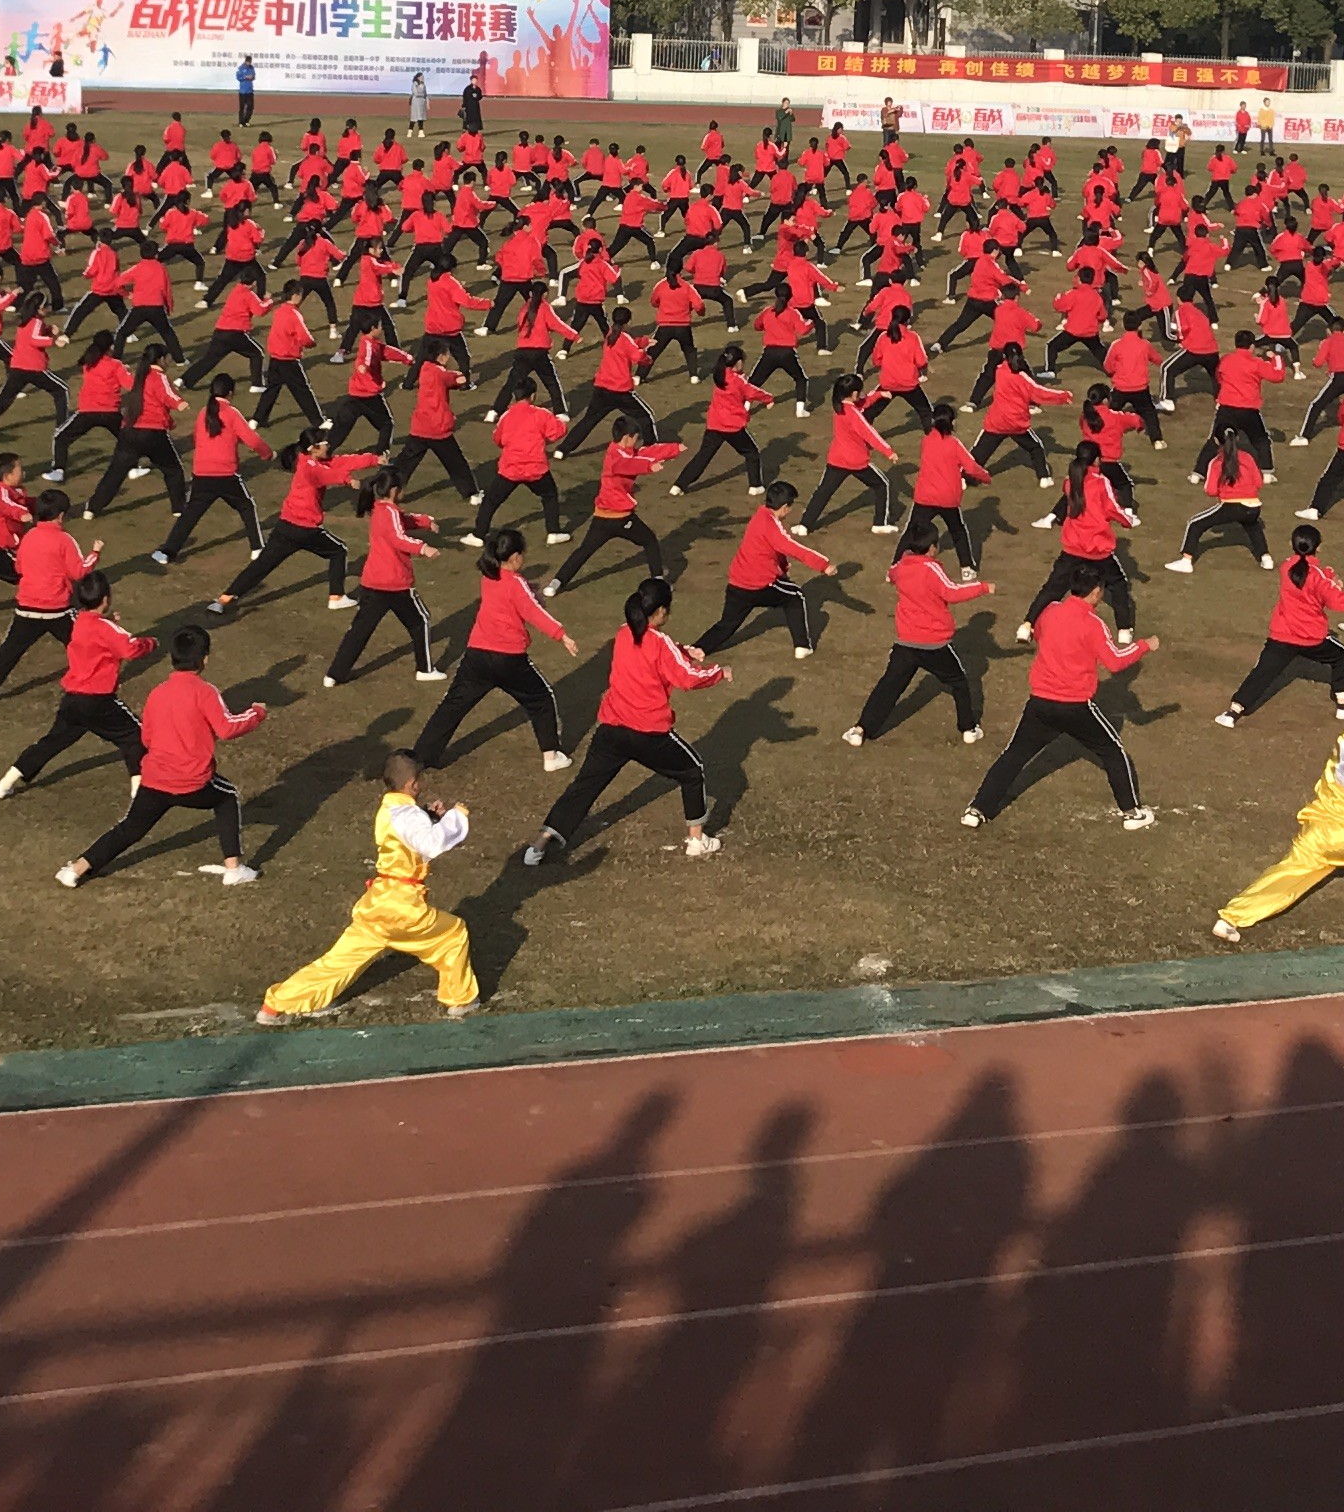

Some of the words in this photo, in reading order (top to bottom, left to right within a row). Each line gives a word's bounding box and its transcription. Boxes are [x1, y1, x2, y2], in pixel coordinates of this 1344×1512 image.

[817, 55, 917, 74] 团结拼搏
[938, 59, 1035, 77] 再创佳绩
[1056, 64, 1150, 81] 飞越梦想
[1173, 67, 1262, 85] 自强不息
